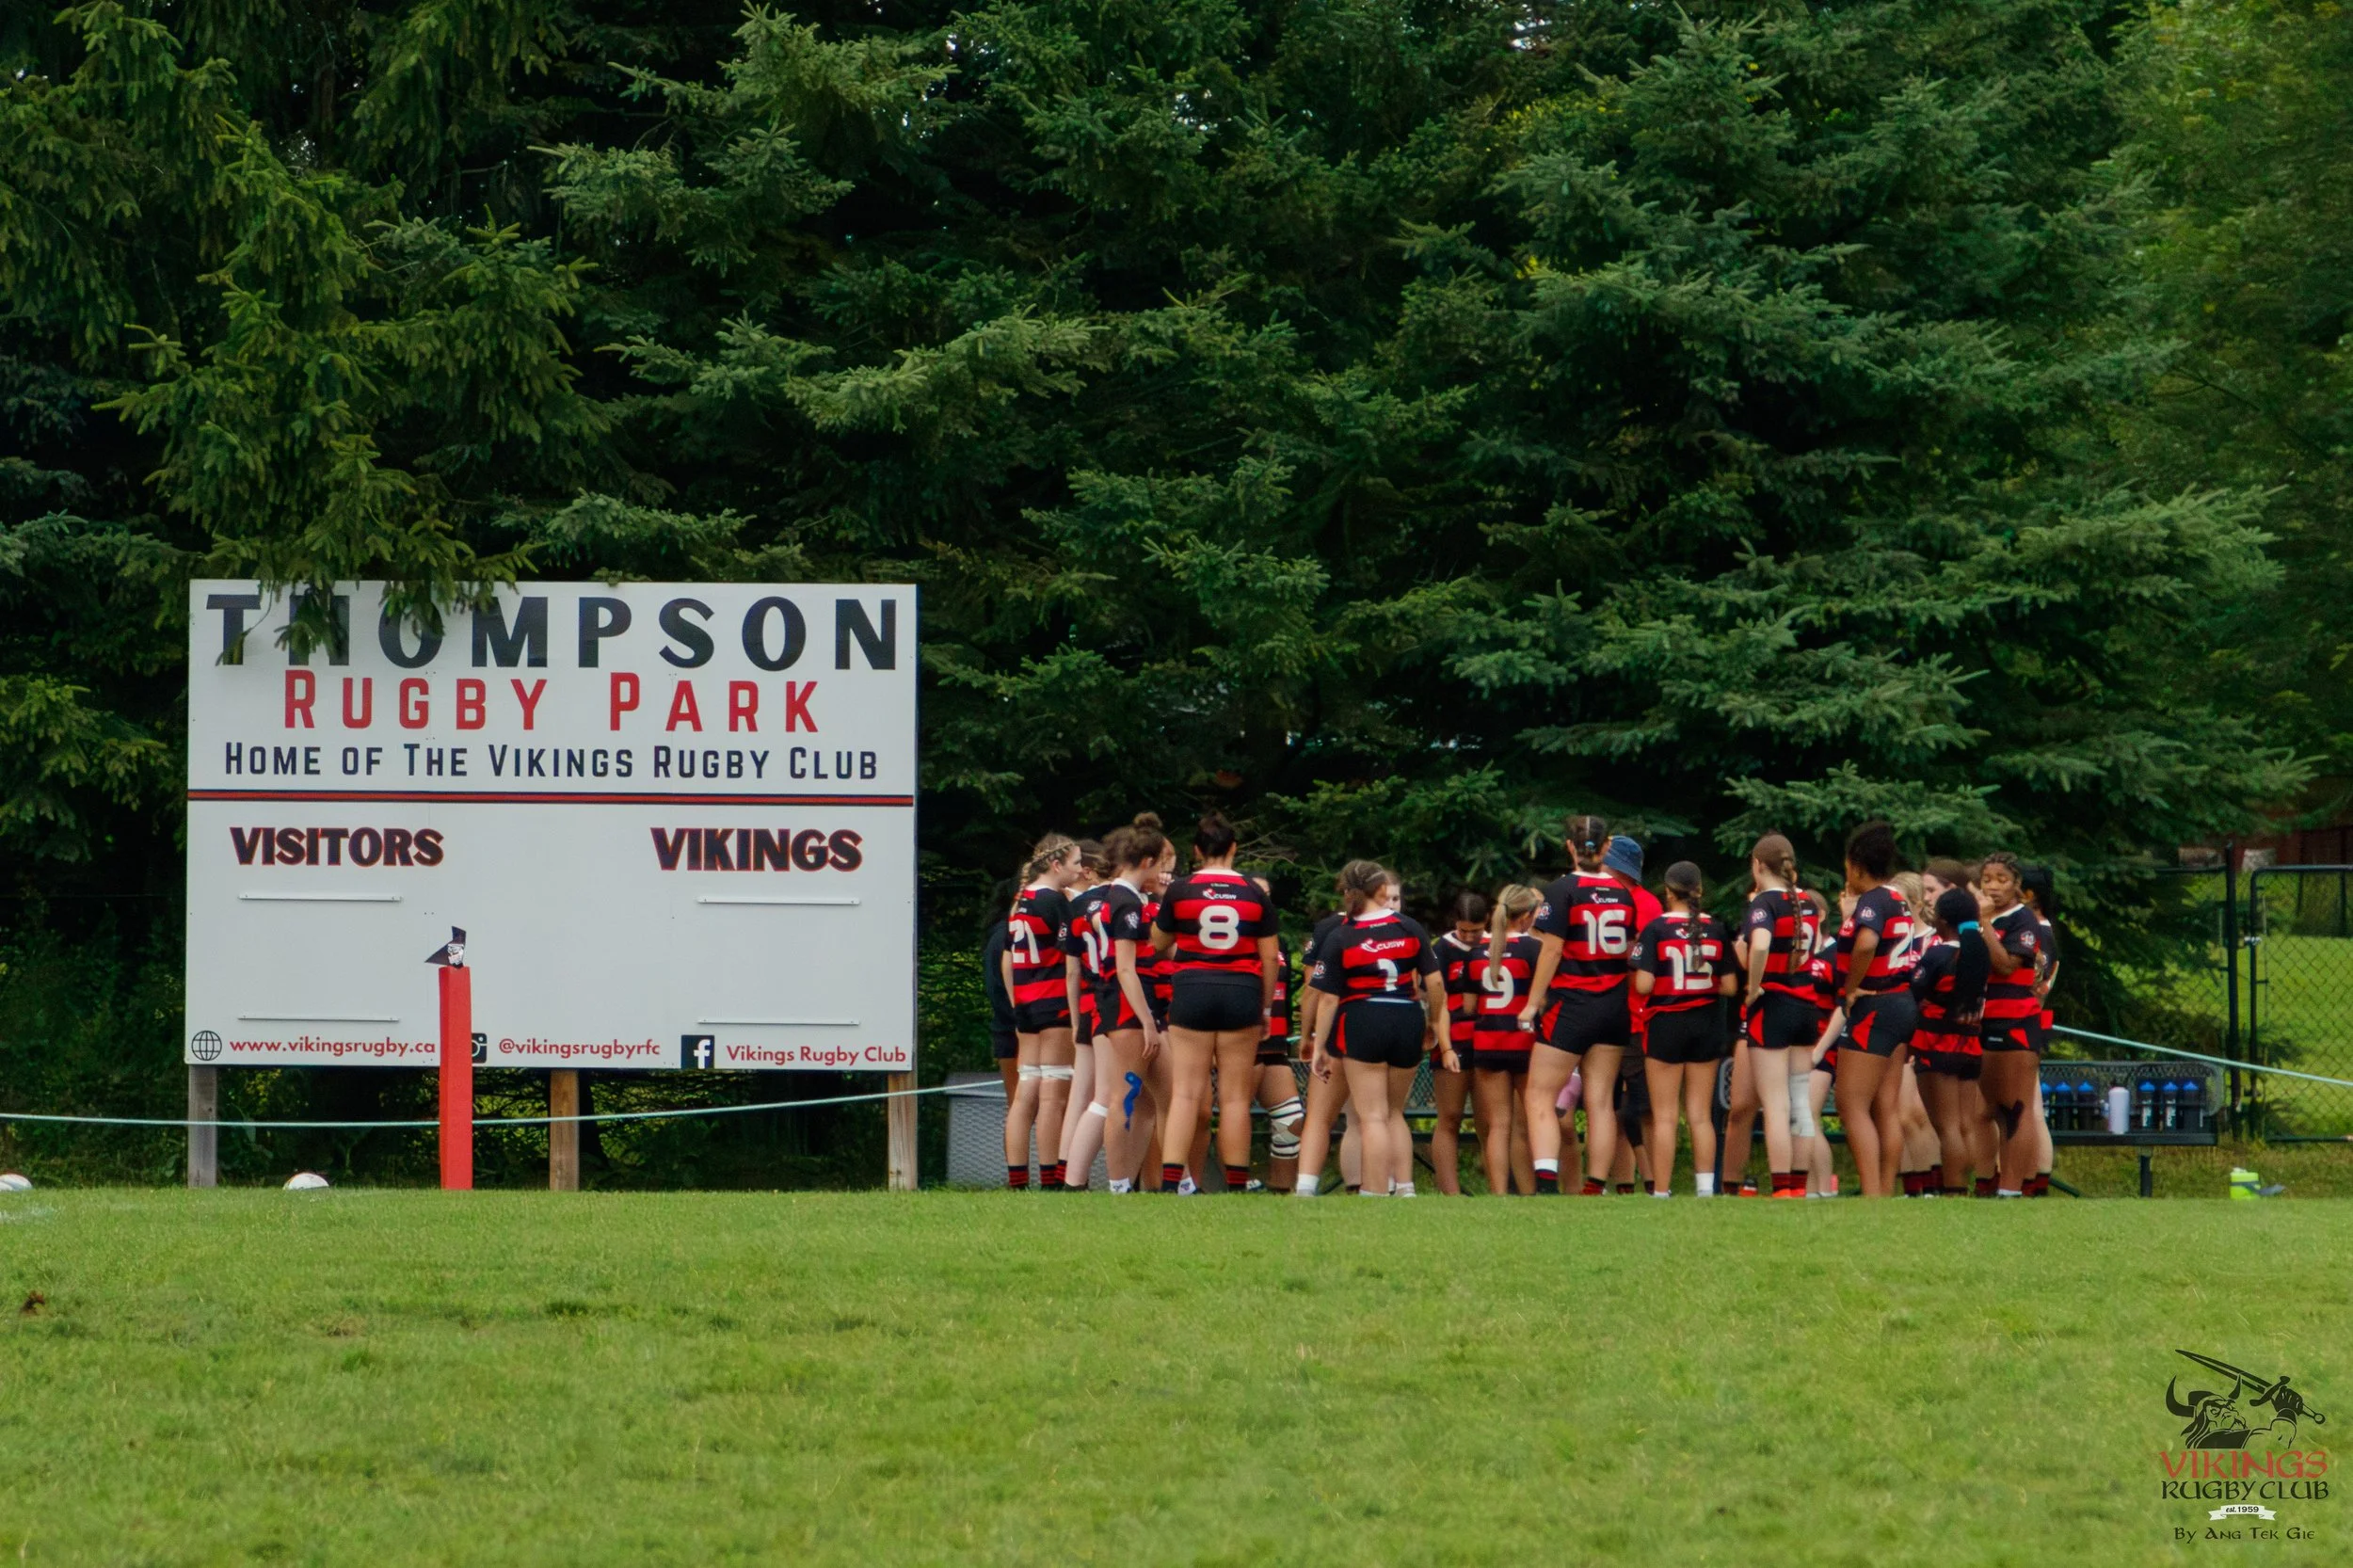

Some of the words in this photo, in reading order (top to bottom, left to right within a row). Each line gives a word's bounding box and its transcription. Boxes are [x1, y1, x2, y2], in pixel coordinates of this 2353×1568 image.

[284, 669, 548, 730] RUGBY
[610, 672, 819, 733] PARK
[225, 742, 321, 776] HOME
[342, 746, 383, 776] OF
[403, 743, 468, 776] THE
[488, 744, 633, 778] VIKINGS
[653, 745, 770, 779] RUGBY
[789, 746, 877, 780] CLUB
[229, 826, 444, 867] VISITORS
[649, 827, 863, 872] VIKINGS
[1008, 919, 1041, 965] 21
[1198, 904, 1241, 951] 8
[1583, 909, 1627, 955] 16
[1481, 965, 1514, 1009] 9
[1665, 943, 1717, 990] 15
[230, 1035, 436, 1057] www.vikingsrugby.ca
[498, 1038, 662, 1060] @vikingsrugbyrfc
[726, 1045, 795, 1065] Vikings
[800, 1046, 859, 1066] Rugby
[863, 1046, 906, 1063] Club
